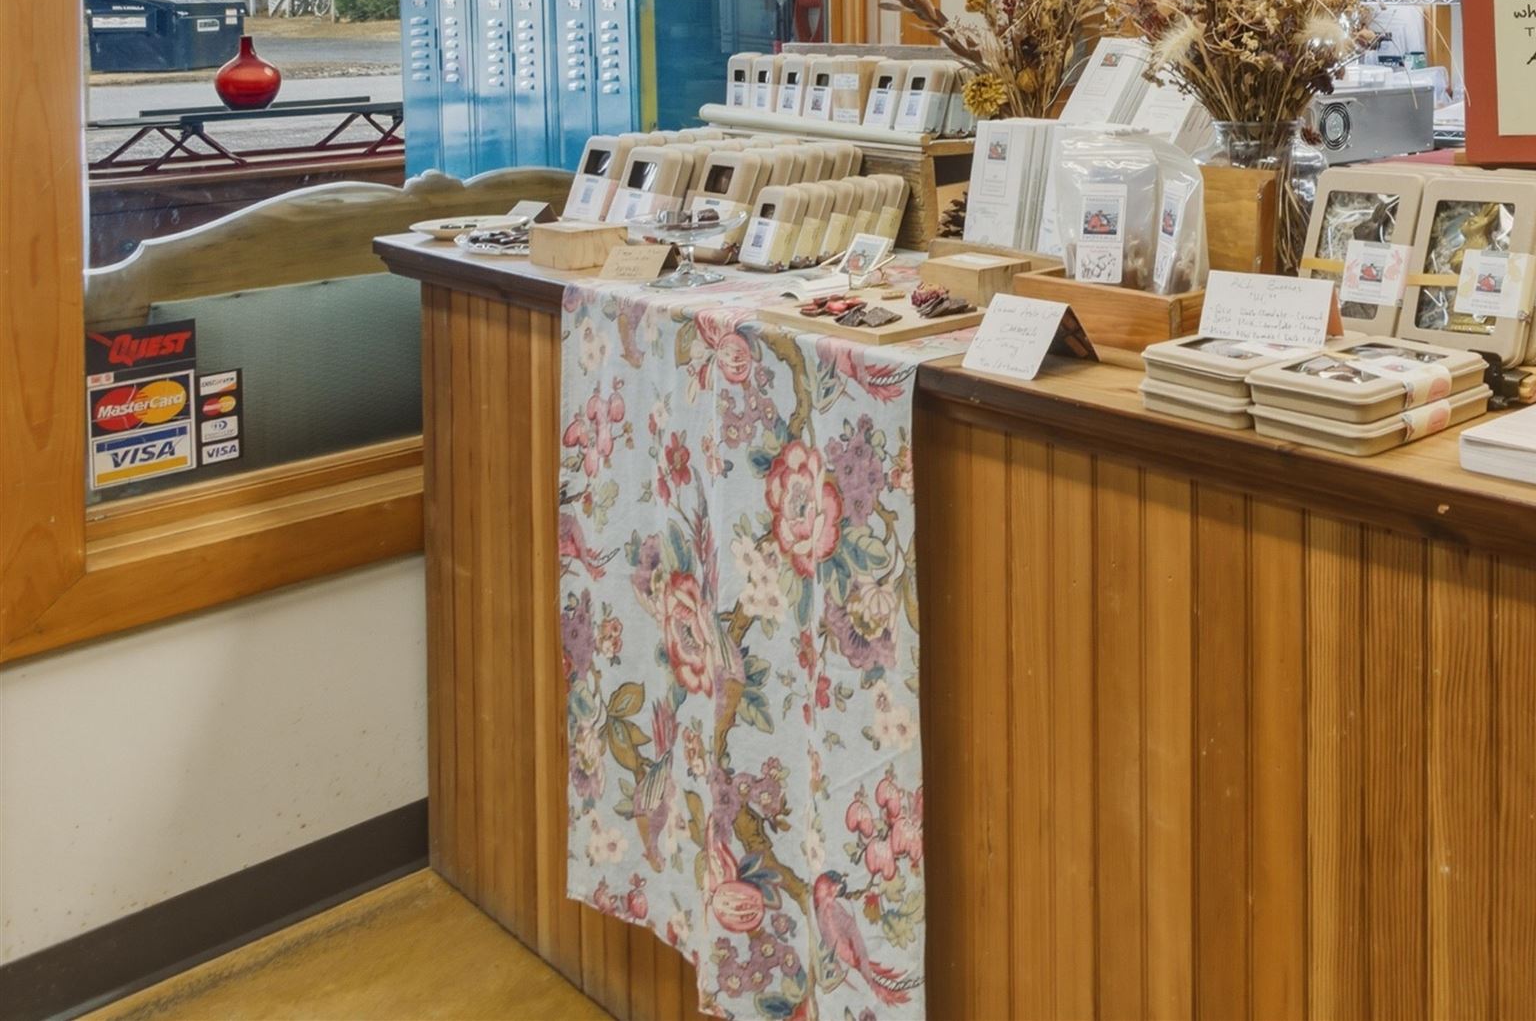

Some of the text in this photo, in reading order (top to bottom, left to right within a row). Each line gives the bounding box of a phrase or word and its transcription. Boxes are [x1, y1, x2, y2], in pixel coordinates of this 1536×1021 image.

[97, 392, 185, 421] MasterCard
[111, 440, 176, 469] VISA
[206, 444, 238, 459] VISA
